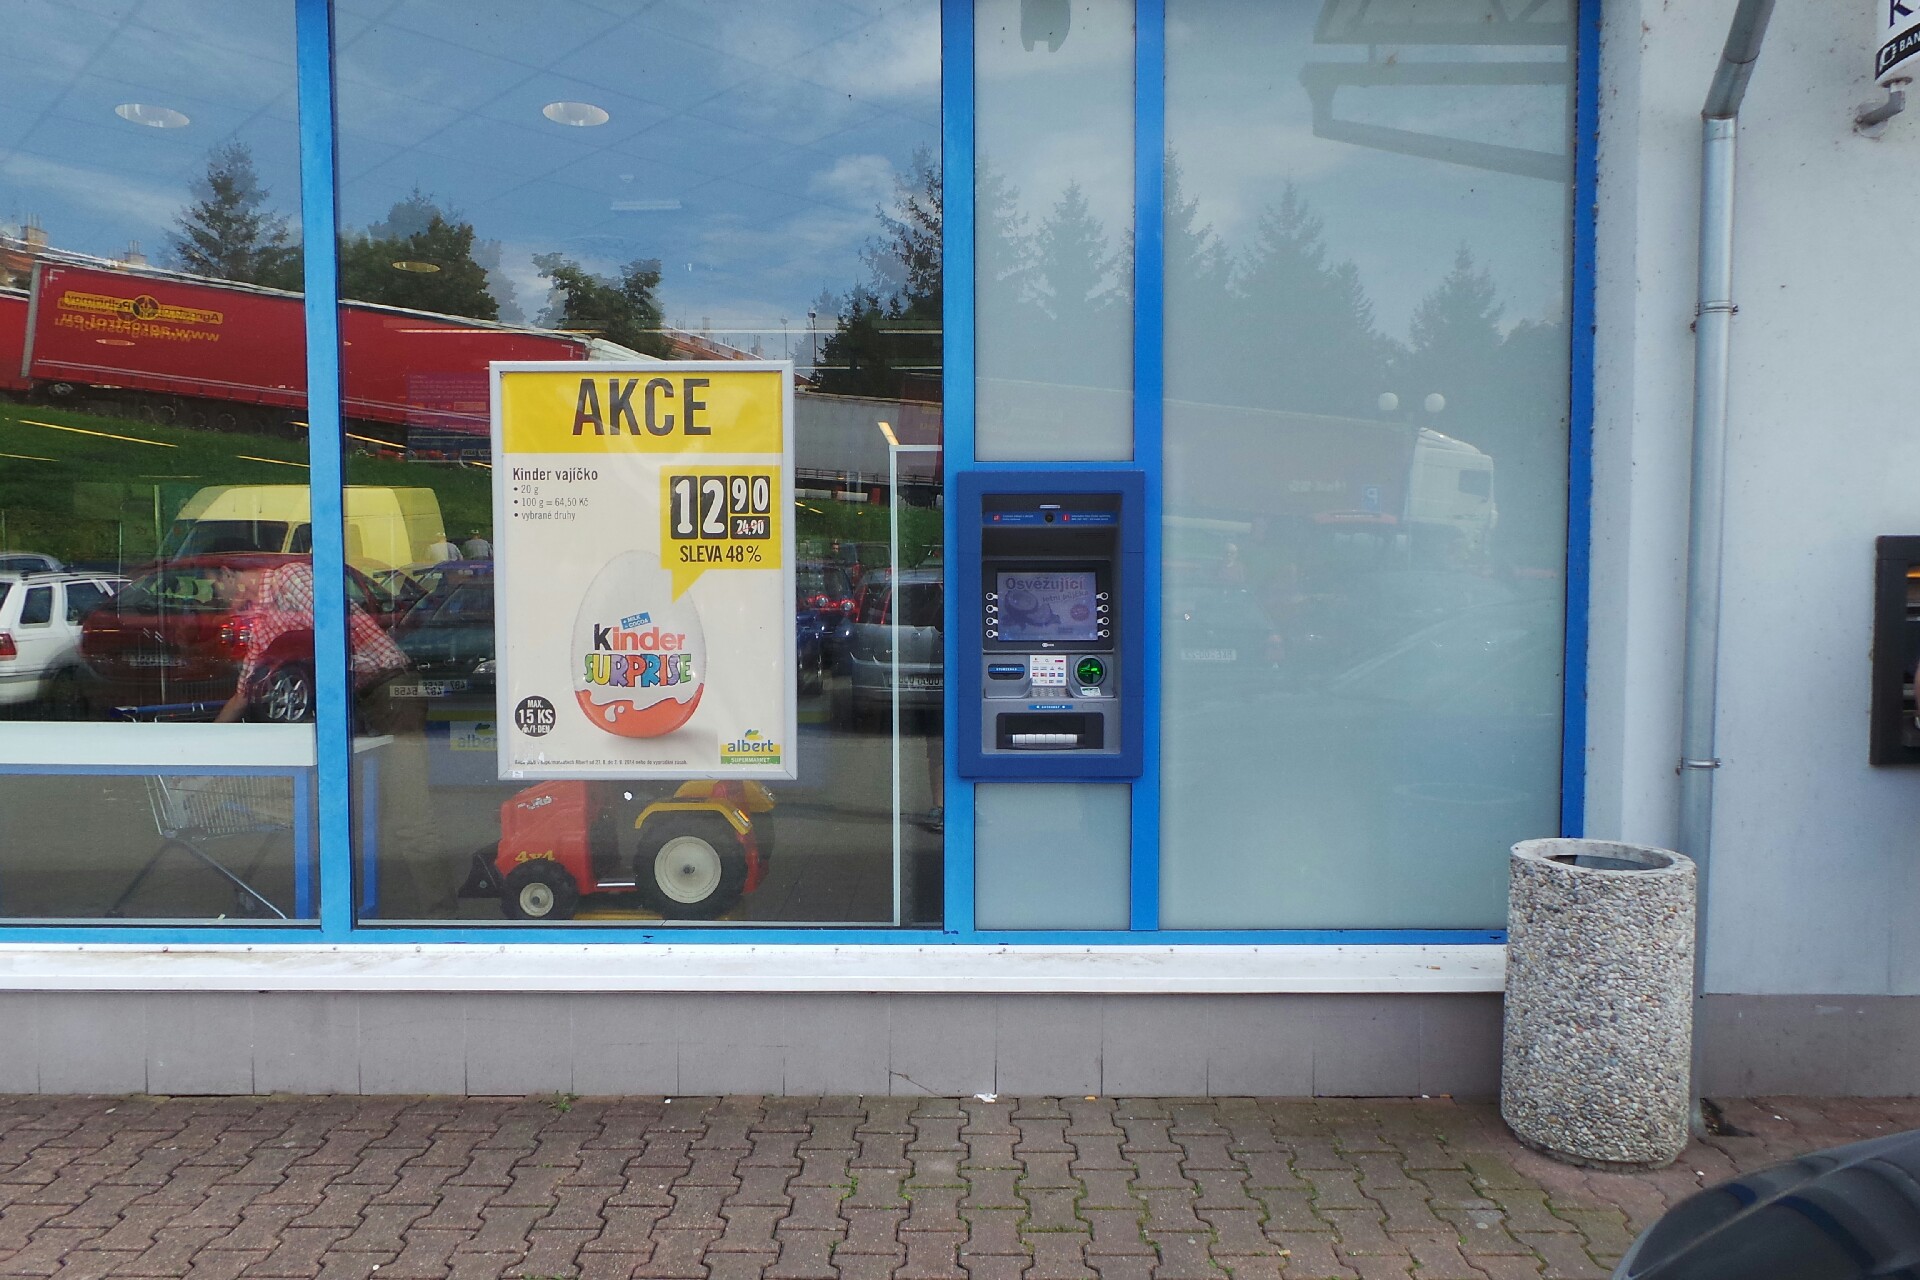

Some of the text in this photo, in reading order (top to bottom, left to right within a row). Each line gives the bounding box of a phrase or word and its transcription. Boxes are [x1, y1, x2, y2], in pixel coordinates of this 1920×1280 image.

[572, 378, 712, 436] AKCE
[512, 467, 598, 483] Kinder vajíčko
[521, 484, 539, 495] 20 g
[522, 497, 536, 507] 100
[539, 499, 544, 508] g
[555, 497, 577, 508] 64,50
[579, 497, 589, 507] Kč
[675, 477, 769, 534] 12 90
[521, 510, 576, 521] vybrané druhy
[736, 519, 765, 535] 24,90
[679, 545, 723, 563] SLEVA
[1005, 576, 1084, 592] Osvěžující
[584, 653, 692, 687] SURPRISE
[527, 699, 544, 708] MAX.
[519, 708, 553, 724] 15 KS
[727, 739, 774, 753] albert
